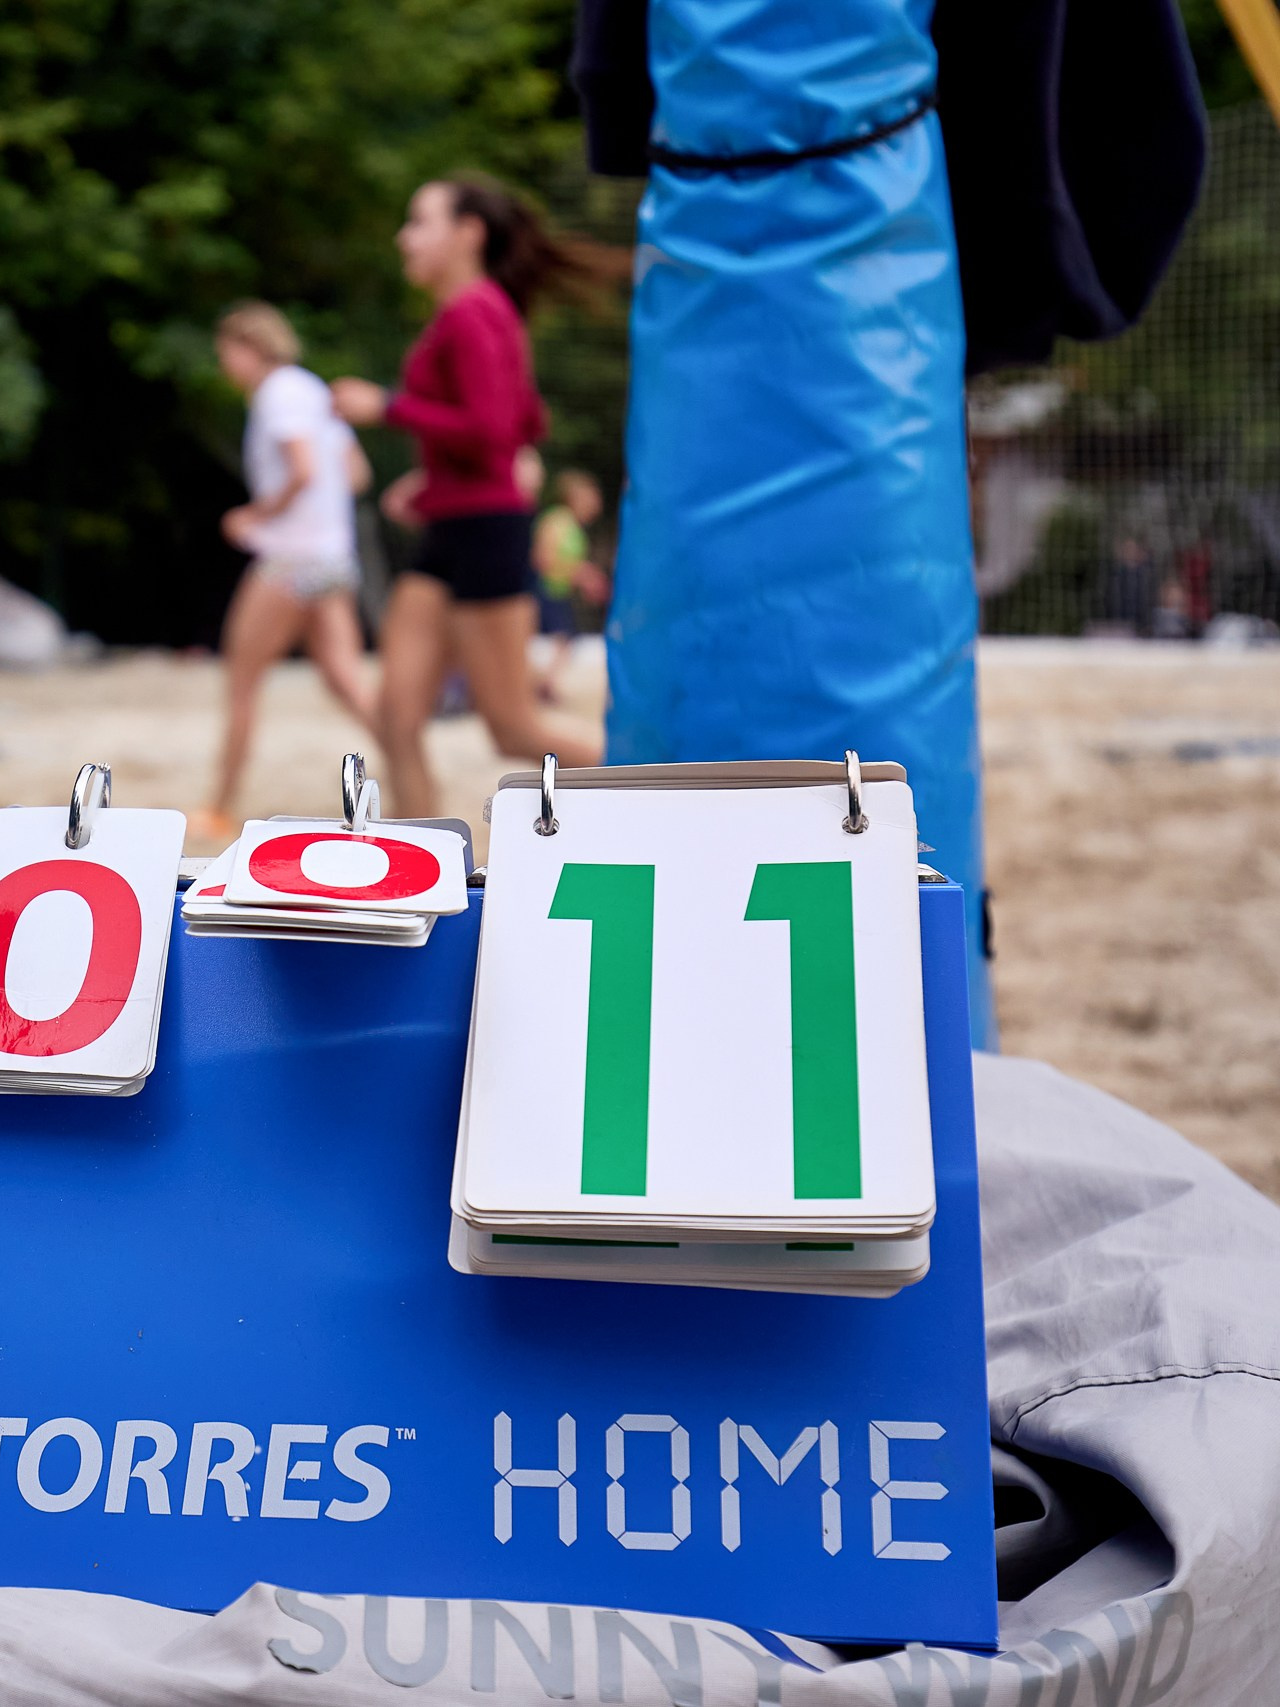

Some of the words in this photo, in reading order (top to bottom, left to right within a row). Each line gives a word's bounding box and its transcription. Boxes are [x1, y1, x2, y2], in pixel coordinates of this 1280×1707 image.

[248, 832, 441, 901] 0
[548, 860, 863, 1201] 11
[493, 1411, 952, 1561] HOME
